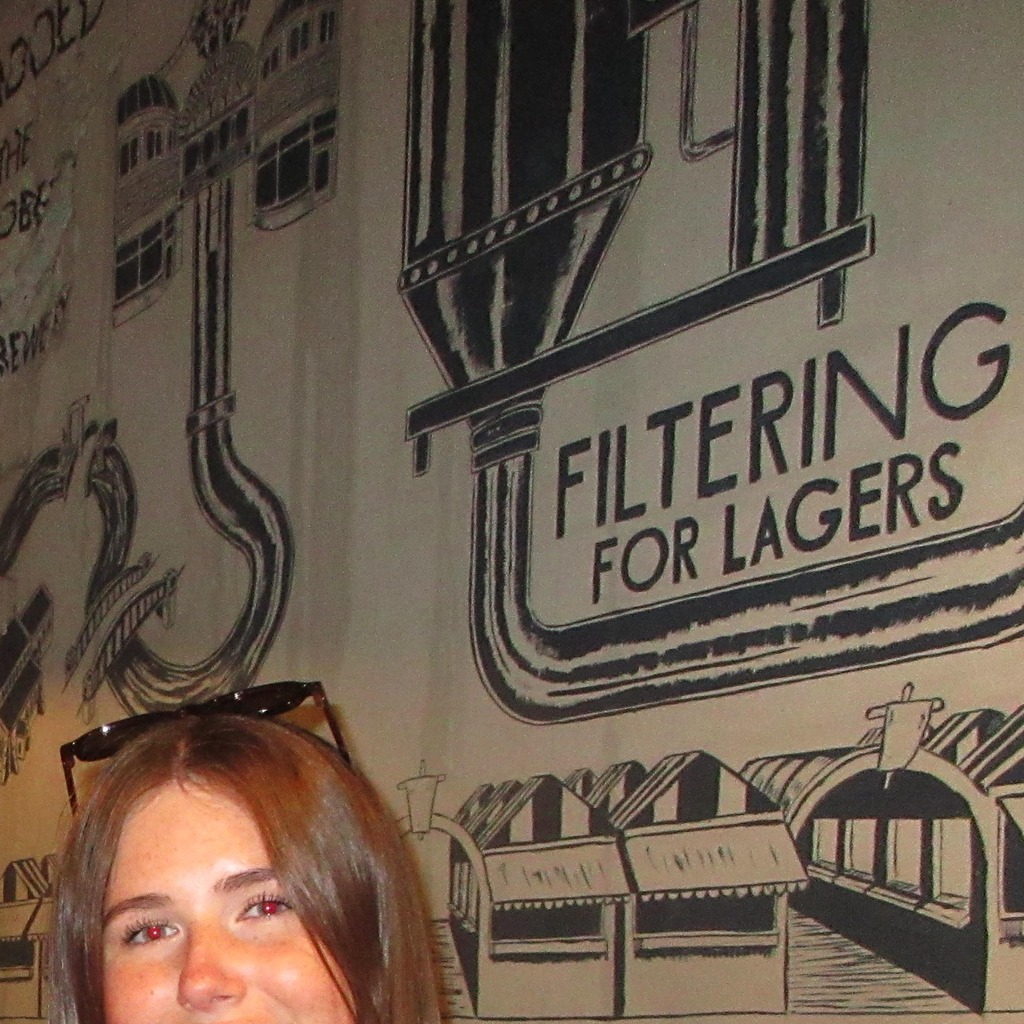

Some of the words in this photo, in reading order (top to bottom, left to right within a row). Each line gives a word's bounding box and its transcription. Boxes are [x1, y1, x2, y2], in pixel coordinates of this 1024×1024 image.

[556, 302, 1011, 540] FILTERING
[592, 515, 699, 604] FOR
[722, 442, 964, 575] LAGERS
